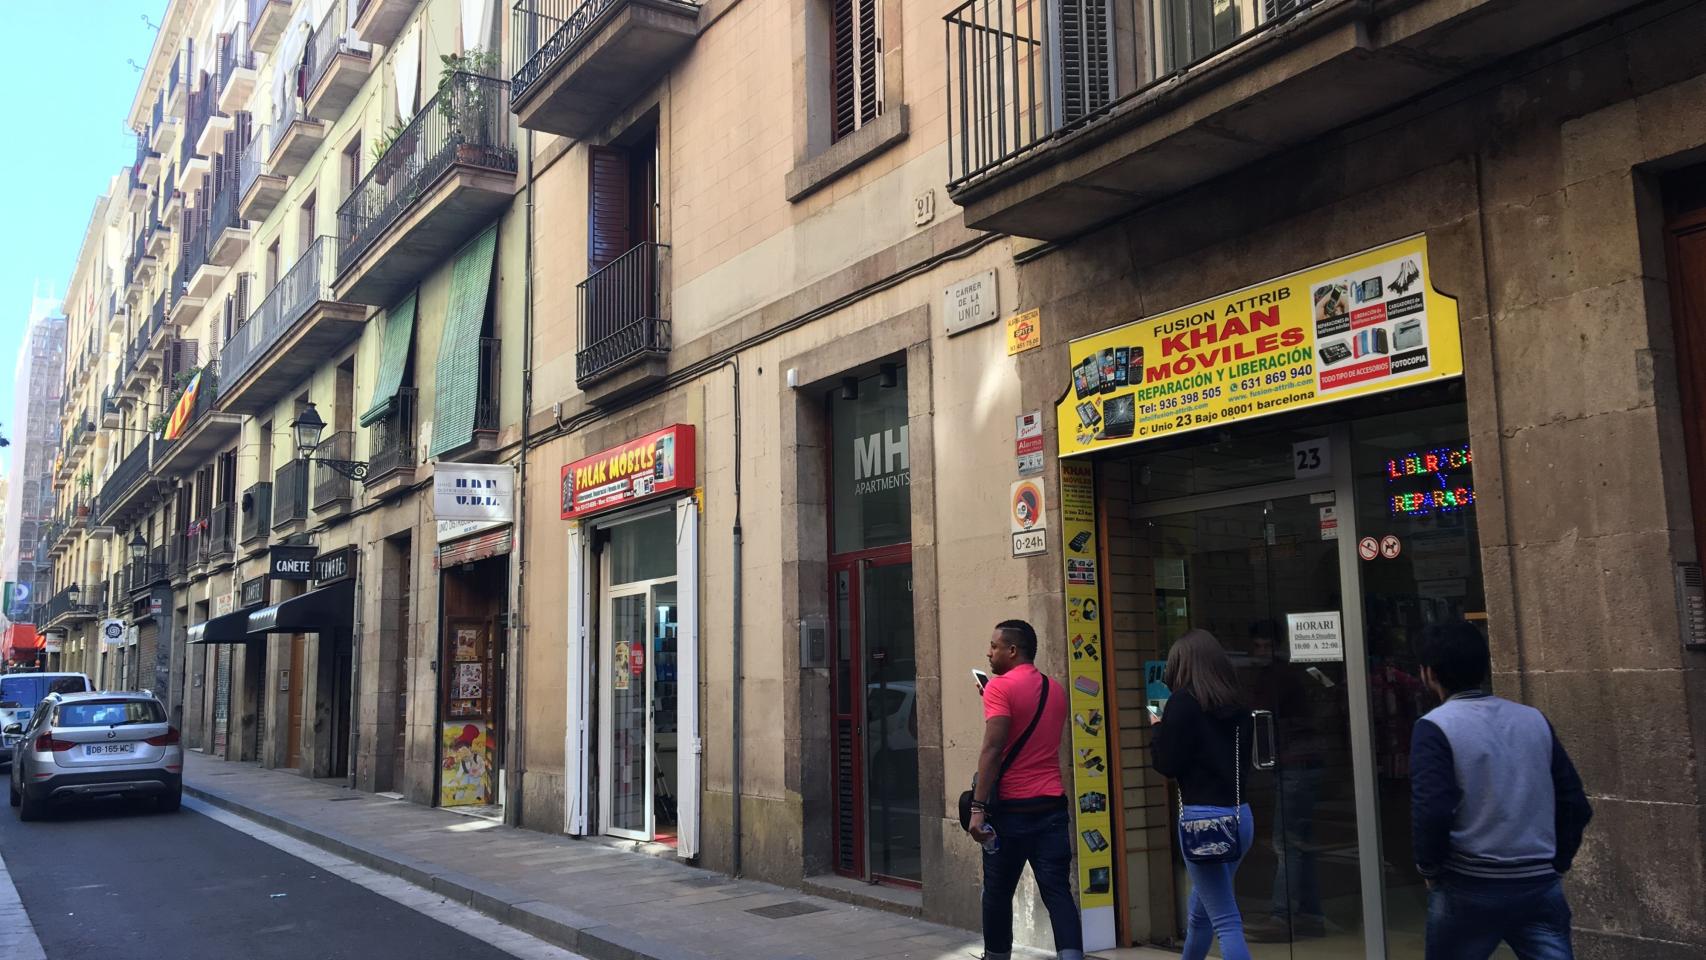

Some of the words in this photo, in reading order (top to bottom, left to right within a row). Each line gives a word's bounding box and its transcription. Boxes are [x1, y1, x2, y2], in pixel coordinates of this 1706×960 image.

[955, 281, 982, 298] CARRER
[958, 297, 967, 307] DE
[970, 291, 979, 303] LA
[958, 301, 980, 322] UNIÓ
[1153, 309, 1215, 338] FUSION
[1225, 287, 1291, 317] ATTRIB
[1161, 304, 1280, 358] KHAN
[1146, 327, 1305, 384] MÓVILES
[1391, 354, 1427, 369] FOTOCOPIA
[1138, 371, 1213, 402] REPARACIÓN
[1216, 368, 1225, 382] Y
[1228, 346, 1313, 379] LIBERACIÓN
[1241, 376, 1261, 391] 631
[1265, 370, 1287, 385] 869
[1290, 364, 1312, 379] 940
[1321, 375, 1336, 384] TODO
[1336, 371, 1348, 381] TIPO
[1348, 370, 1356, 378] DE
[1355, 362, 1389, 376] ACCESORIOS
[1139, 403, 1157, 415] Tel:
[1159, 397, 1178, 411] 936
[1180, 391, 1199, 405] 398
[1202, 386, 1221, 400] 505
[1151, 422, 1173, 433] Unio
[1175, 413, 1192, 428] 23
[1195, 412, 1218, 424] Bajo
[1220, 402, 1253, 418] 08001
[1257, 391, 1315, 410] barcelona
[854, 425, 909, 480] MH
[1019, 439, 1042, 449] Alarma
[1296, 447, 1321, 471] 23
[854, 471, 911, 496] APARTMENTS
[1394, 487, 1477, 512] REPARACI
[276, 558, 310, 573] CAÑETE
[1296, 620, 1334, 631] HORARI
